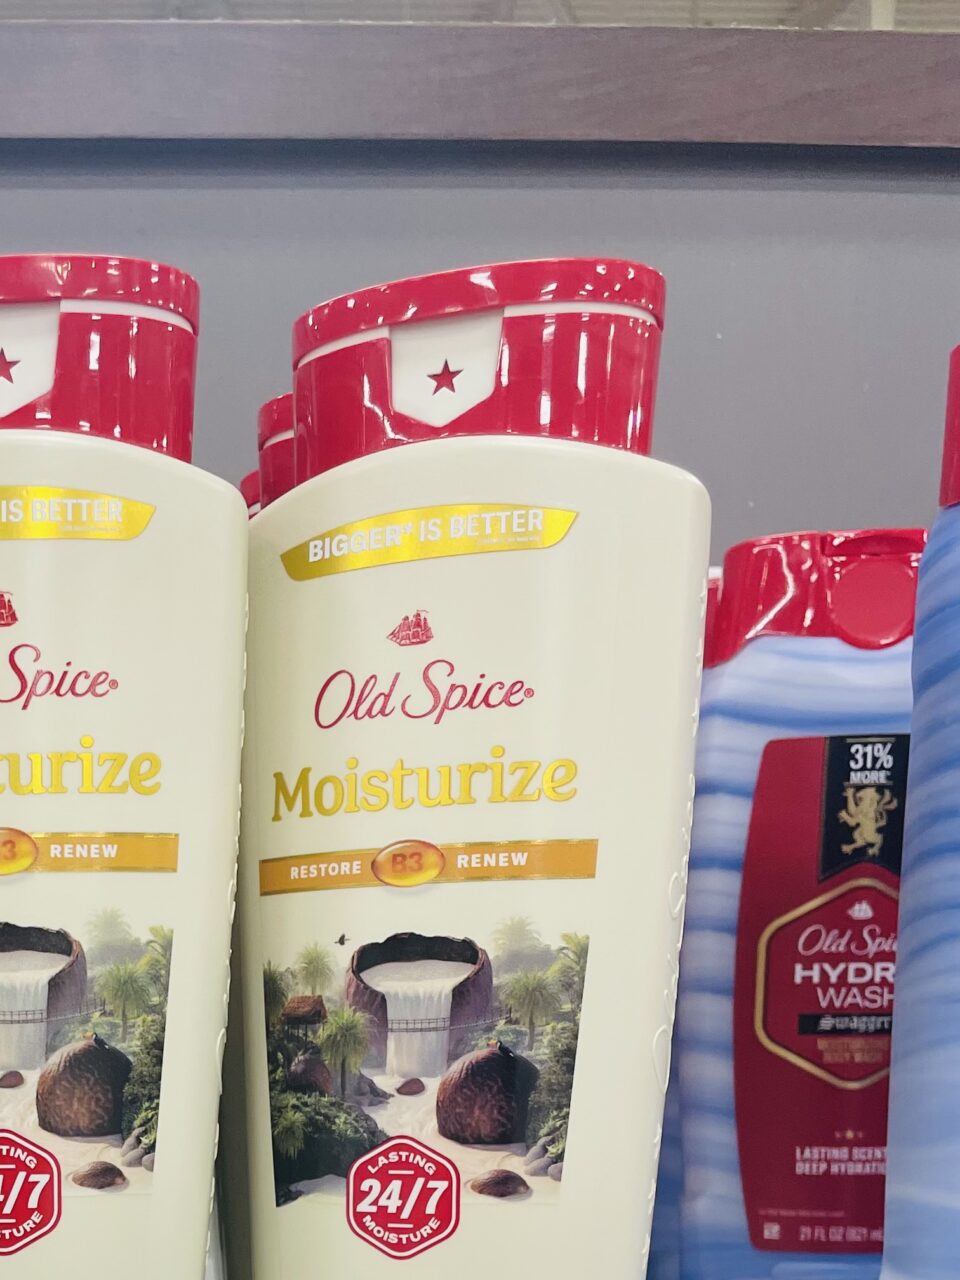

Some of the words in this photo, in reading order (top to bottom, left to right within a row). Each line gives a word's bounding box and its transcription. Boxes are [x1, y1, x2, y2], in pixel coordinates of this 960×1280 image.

[1, 499, 24, 522] IS
[32, 498, 123, 523] BETTER
[419, 518, 441, 542] IS
[449, 509, 544, 538] BETTER
[314, 669, 401, 729] Old
[849, 742, 894, 770] 31%
[271, 745, 578, 822] Moisturize
[50, 843, 118, 859] RENEW
[290, 860, 362, 879] RESTORE
[391, 853, 423, 874] B3
[457, 852, 528, 868] RENEW
[797, 924, 852, 956] Old
[367, 1151, 436, 1176] LASTING
[356, 1177, 449, 1220] 24/7
[362, 1214, 441, 1245] MOISTURE
